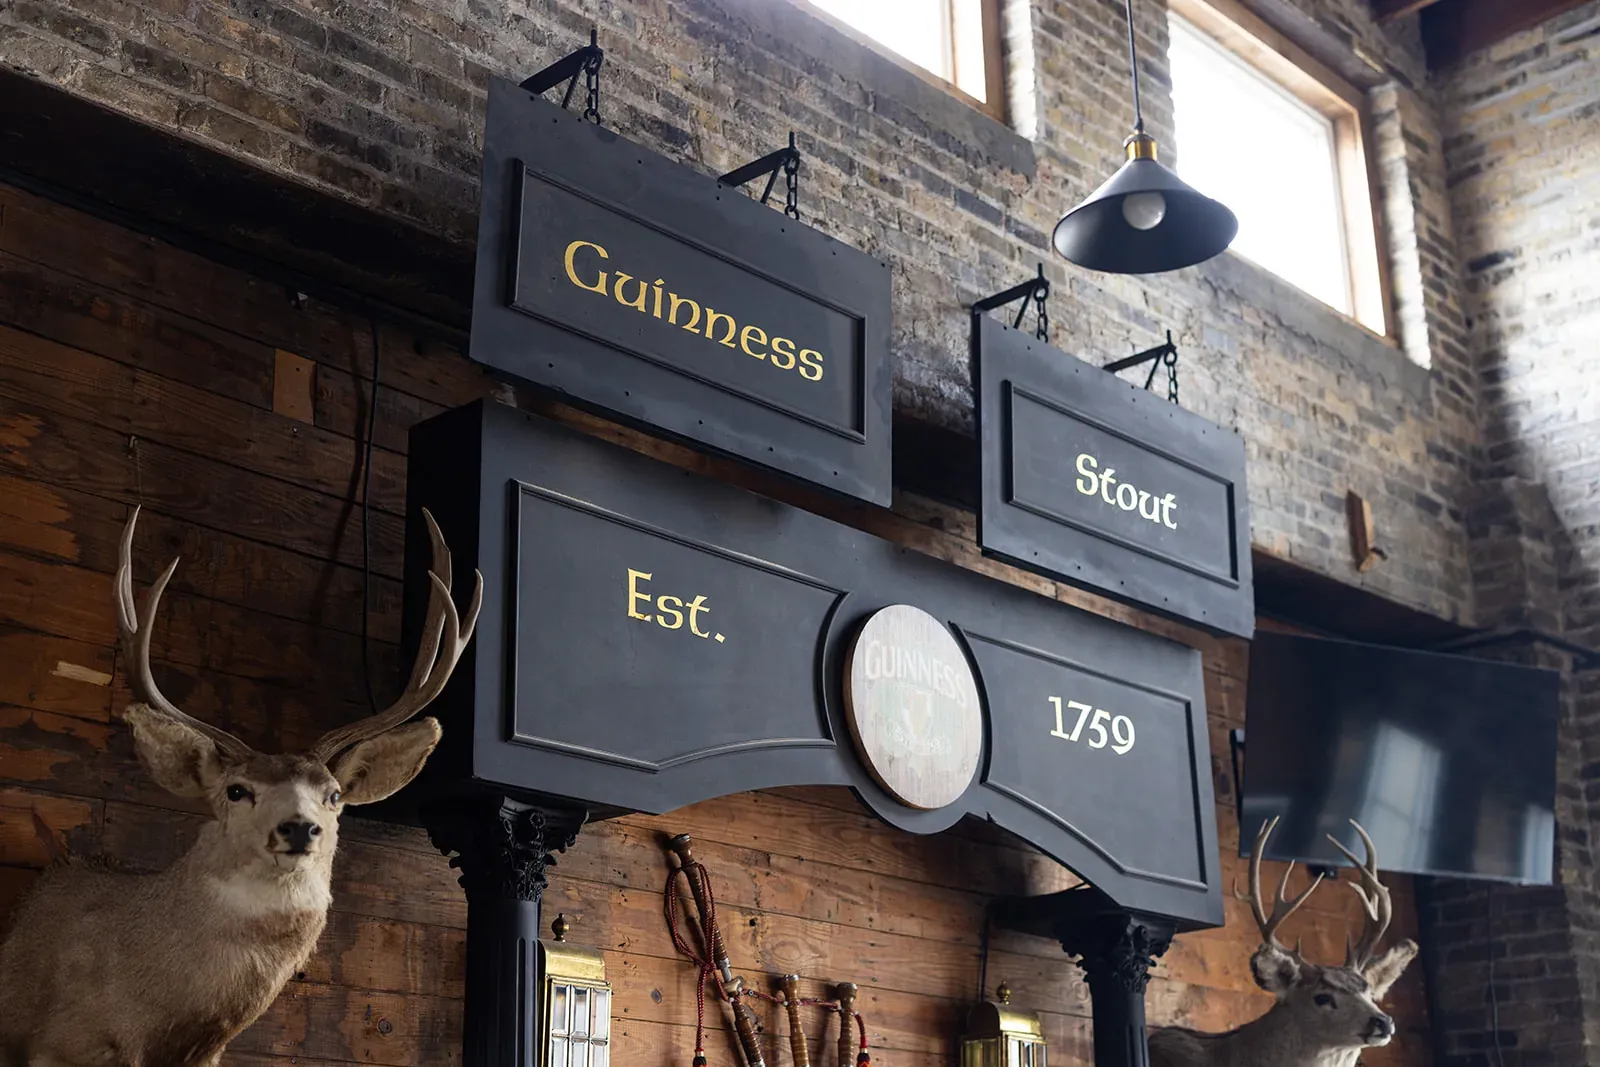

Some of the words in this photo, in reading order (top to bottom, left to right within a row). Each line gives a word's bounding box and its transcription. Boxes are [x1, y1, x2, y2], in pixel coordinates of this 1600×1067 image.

[564, 240, 824, 382] Guinness
[1075, 453, 1178, 530] Stout
[626, 567, 726, 644] Est.
[864, 640, 967, 708] GUINNESS
[1047, 695, 1136, 756] 1759
